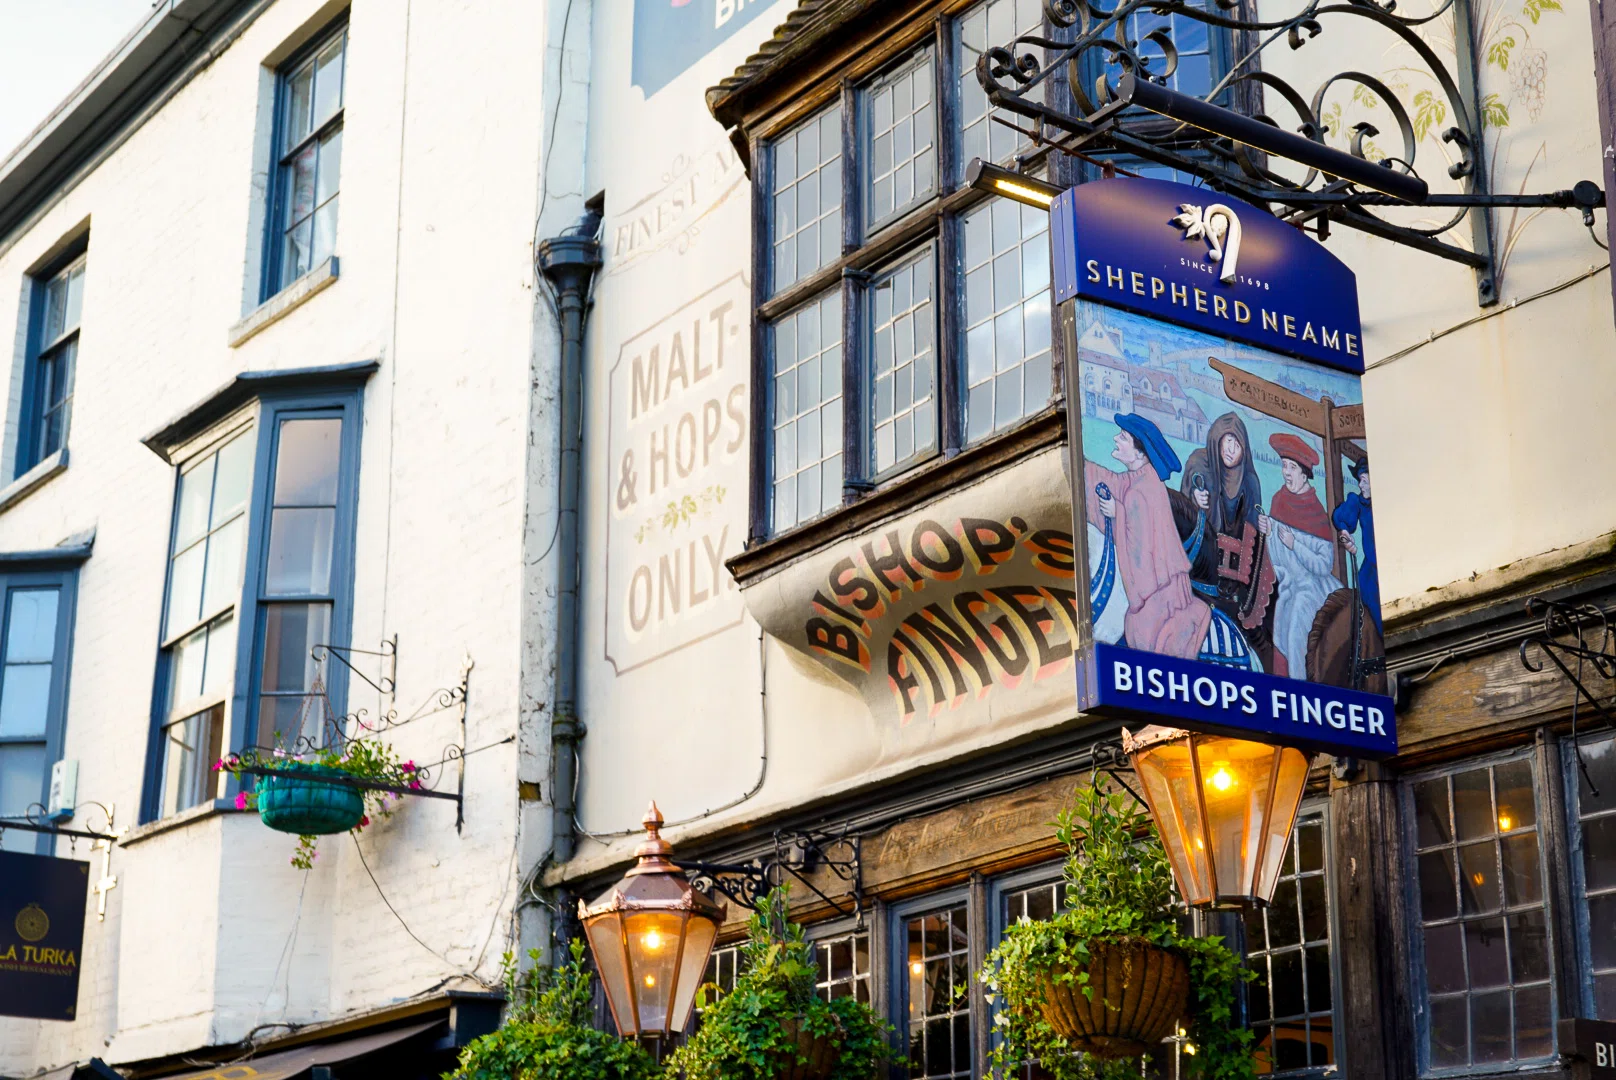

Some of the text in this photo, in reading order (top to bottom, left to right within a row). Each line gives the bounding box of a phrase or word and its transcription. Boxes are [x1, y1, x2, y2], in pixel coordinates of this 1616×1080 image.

[614, 171, 700, 257] FINEST
[1086, 259, 1360, 356] SHEPHERD NEAME
[1180, 257, 1270, 290] SINCE 1698
[1240, 381, 1310, 418] CANTERBURY
[616, 384, 747, 510] & HOPS
[806, 516, 1076, 674] BISHOP'S
[1113, 661, 1387, 736] BISHOPS FINGER
[22, 945, 76, 967] TURKA
